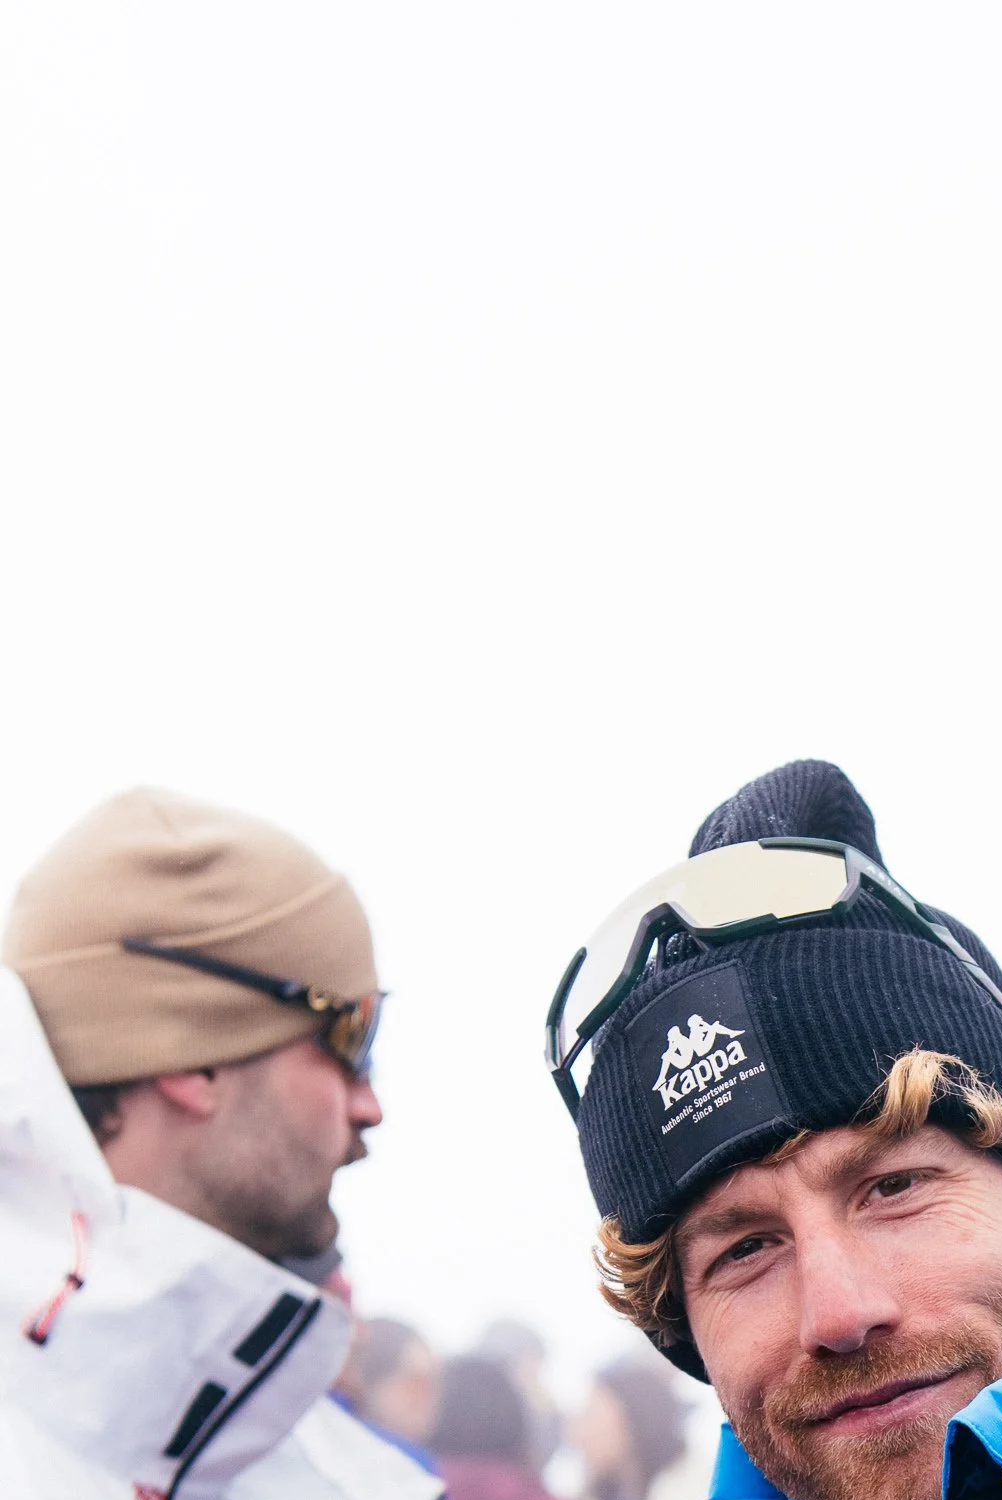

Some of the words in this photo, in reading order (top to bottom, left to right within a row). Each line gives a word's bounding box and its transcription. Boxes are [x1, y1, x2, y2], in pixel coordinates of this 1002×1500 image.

[658, 1040, 747, 1111] Kappa
[661, 1104, 694, 1135] Authentic
[693, 1076, 738, 1108] Sportswear
[738, 1062, 766, 1081] Brand
[692, 1104, 714, 1124] Since
[714, 1091, 733, 1108] 1967
